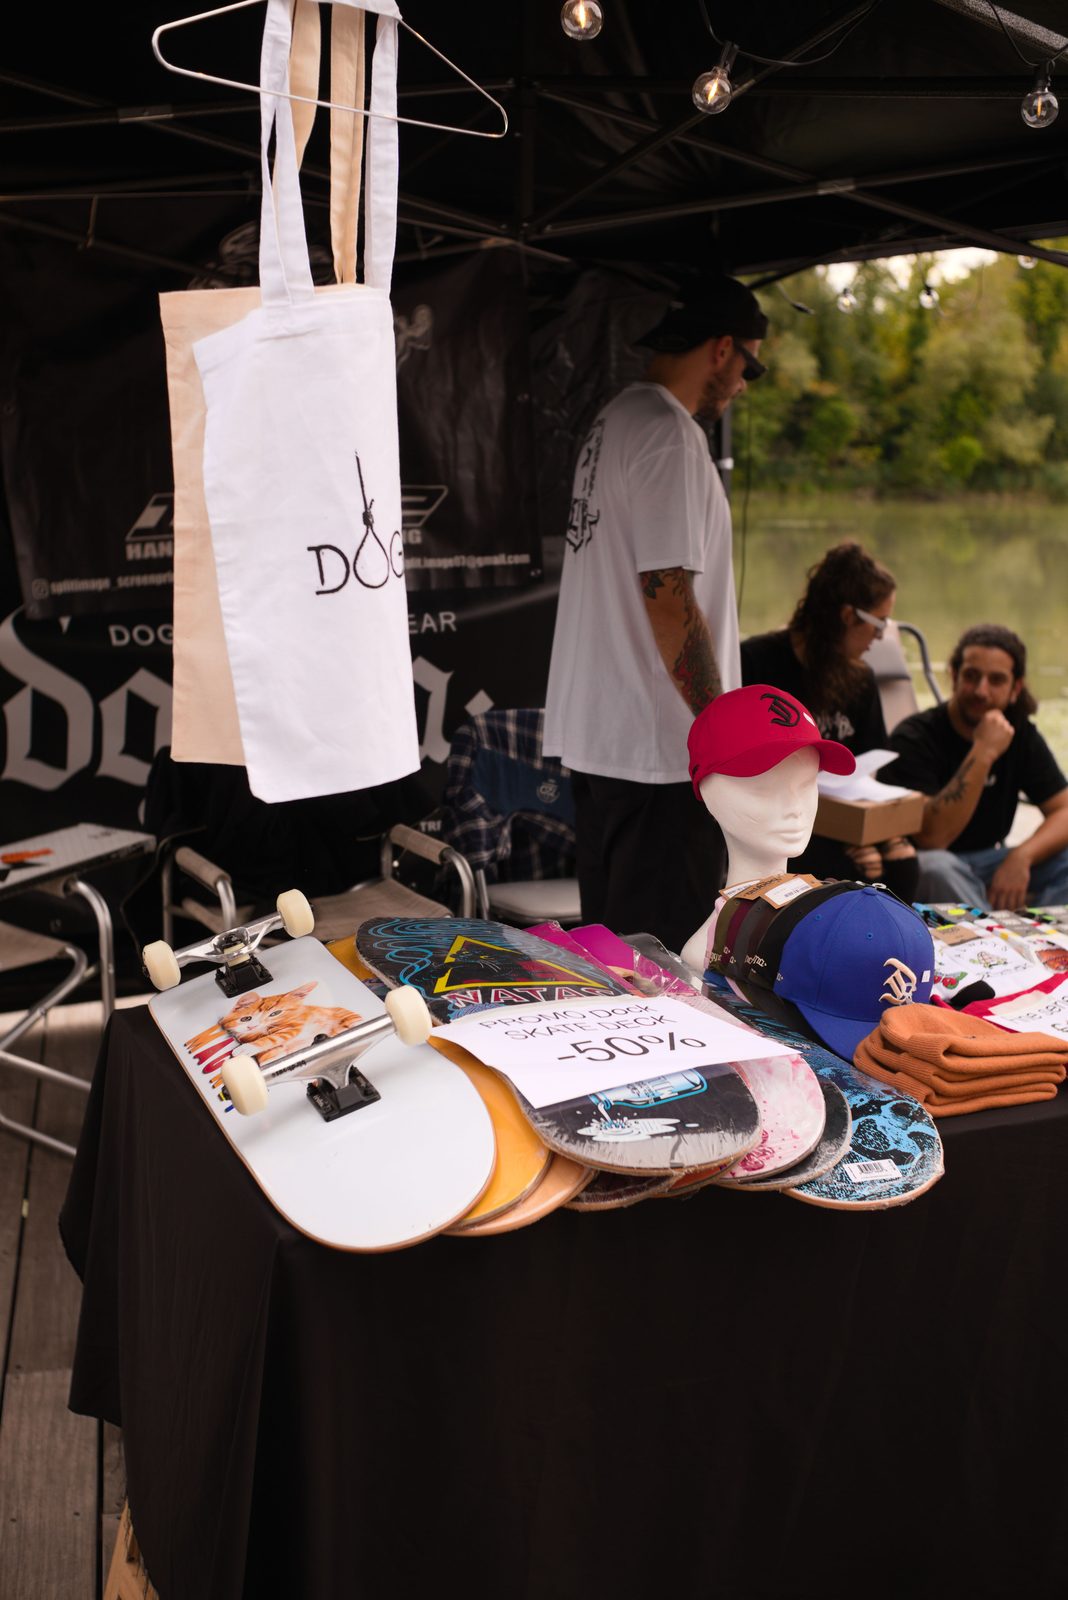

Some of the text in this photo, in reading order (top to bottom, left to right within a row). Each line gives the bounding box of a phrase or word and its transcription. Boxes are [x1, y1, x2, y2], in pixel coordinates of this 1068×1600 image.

[479, 1010, 587, 1030] PROMO
[504, 1014, 677, 1041] SKATE DECK
[557, 1031, 707, 1062] -50%
